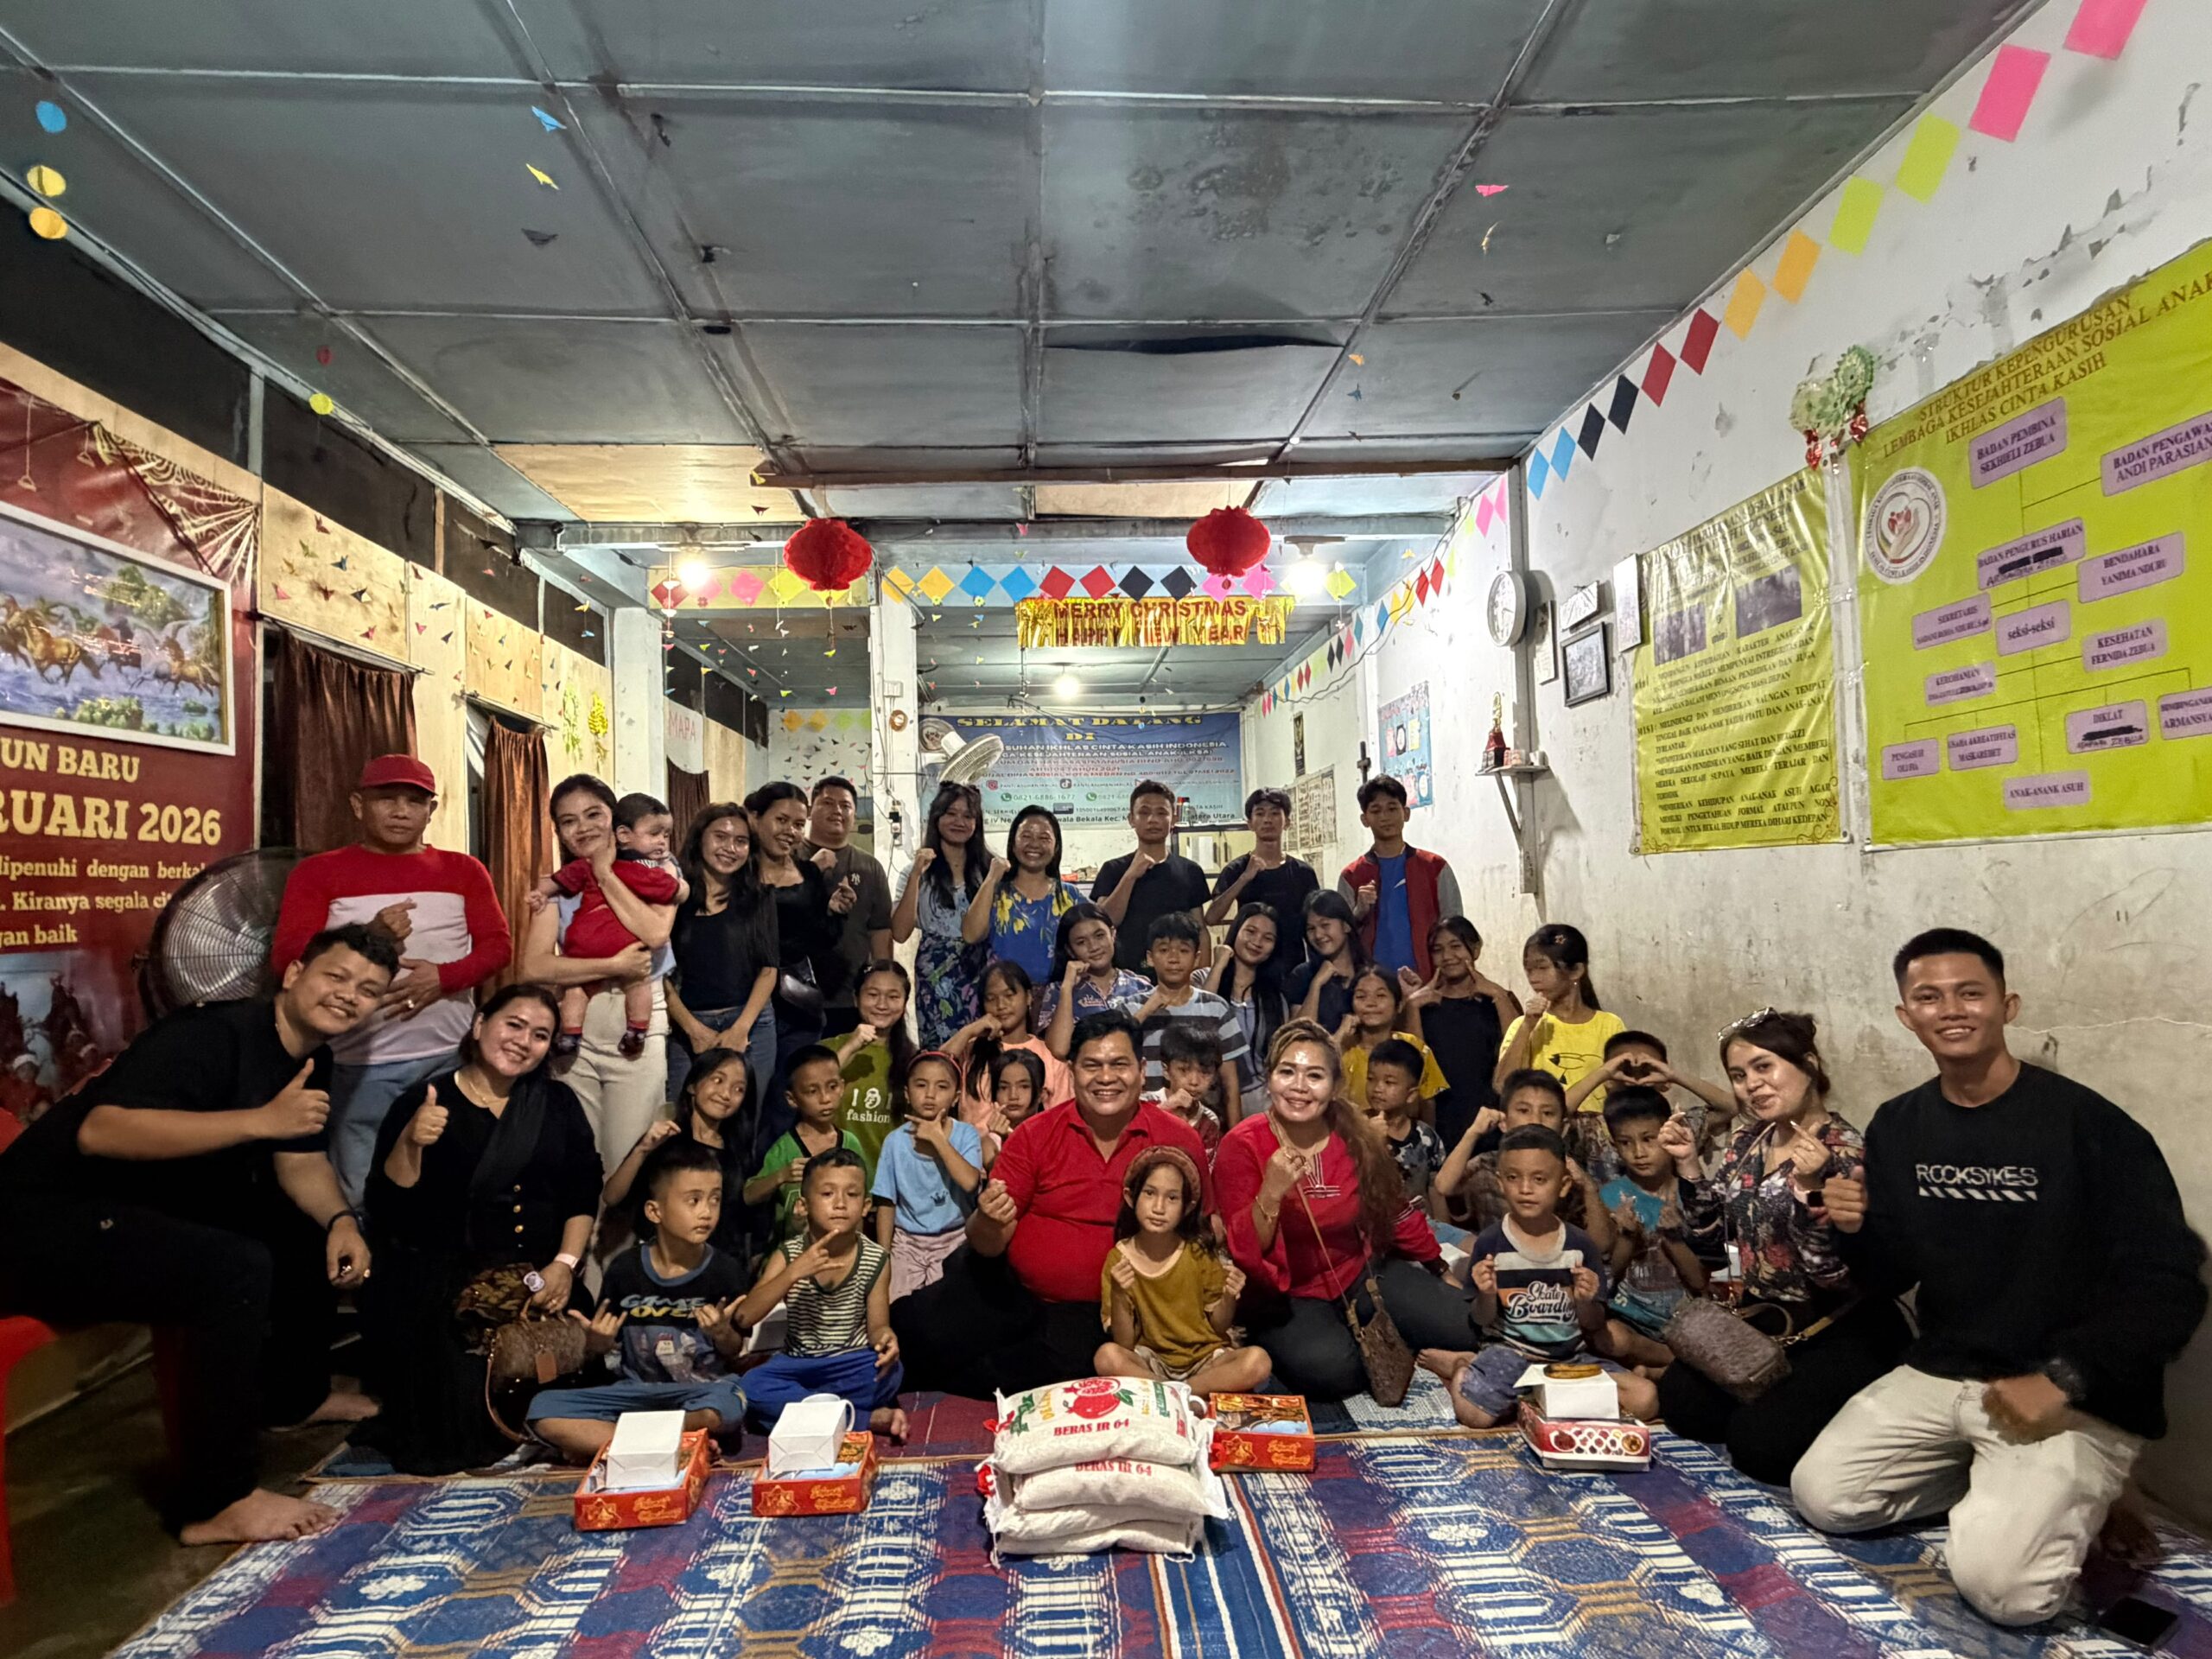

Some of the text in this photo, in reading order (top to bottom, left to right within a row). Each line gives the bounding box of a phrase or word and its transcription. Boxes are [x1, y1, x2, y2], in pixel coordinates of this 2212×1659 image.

[1919, 295, 2130, 422] STRUKTUR KEPENGURUSAN
[1884, 419, 1945, 458] LEMBAGA
[1948, 342, 2078, 423] KESEJAHTERAAN
[2082, 307, 2152, 352] SOSIAL
[1947, 352, 2106, 444] IKHLAS CINTA KASIH
[1977, 411, 2055, 461] BADAN PEMBINA
[2113, 423, 2212, 469] BADAN PENGAWA
[2117, 461, 2146, 482] ANDI
[2007, 615, 2055, 641] seksi-seksi
[2097, 625, 2152, 649] KESEHATAN
[1065, 732, 1096, 741] DI
[57, 746, 140, 783] BARU
[138, 803, 221, 846] 2026
[0, 855, 206, 882] ipenuhi dengan berka
[12, 890, 172, 915] Kiranya segala ci
[35, 923, 78, 944] baik
[846, 1109, 890, 1123] fashion
[1916, 1164, 2038, 1186] ROCKSYKES
[1528, 1281, 1568, 1302] Skate
[630, 1306, 692, 1318] OVE
[1054, 1418, 1130, 1437] BERAS IR 64
[1135, 1465, 1153, 1477] 64
